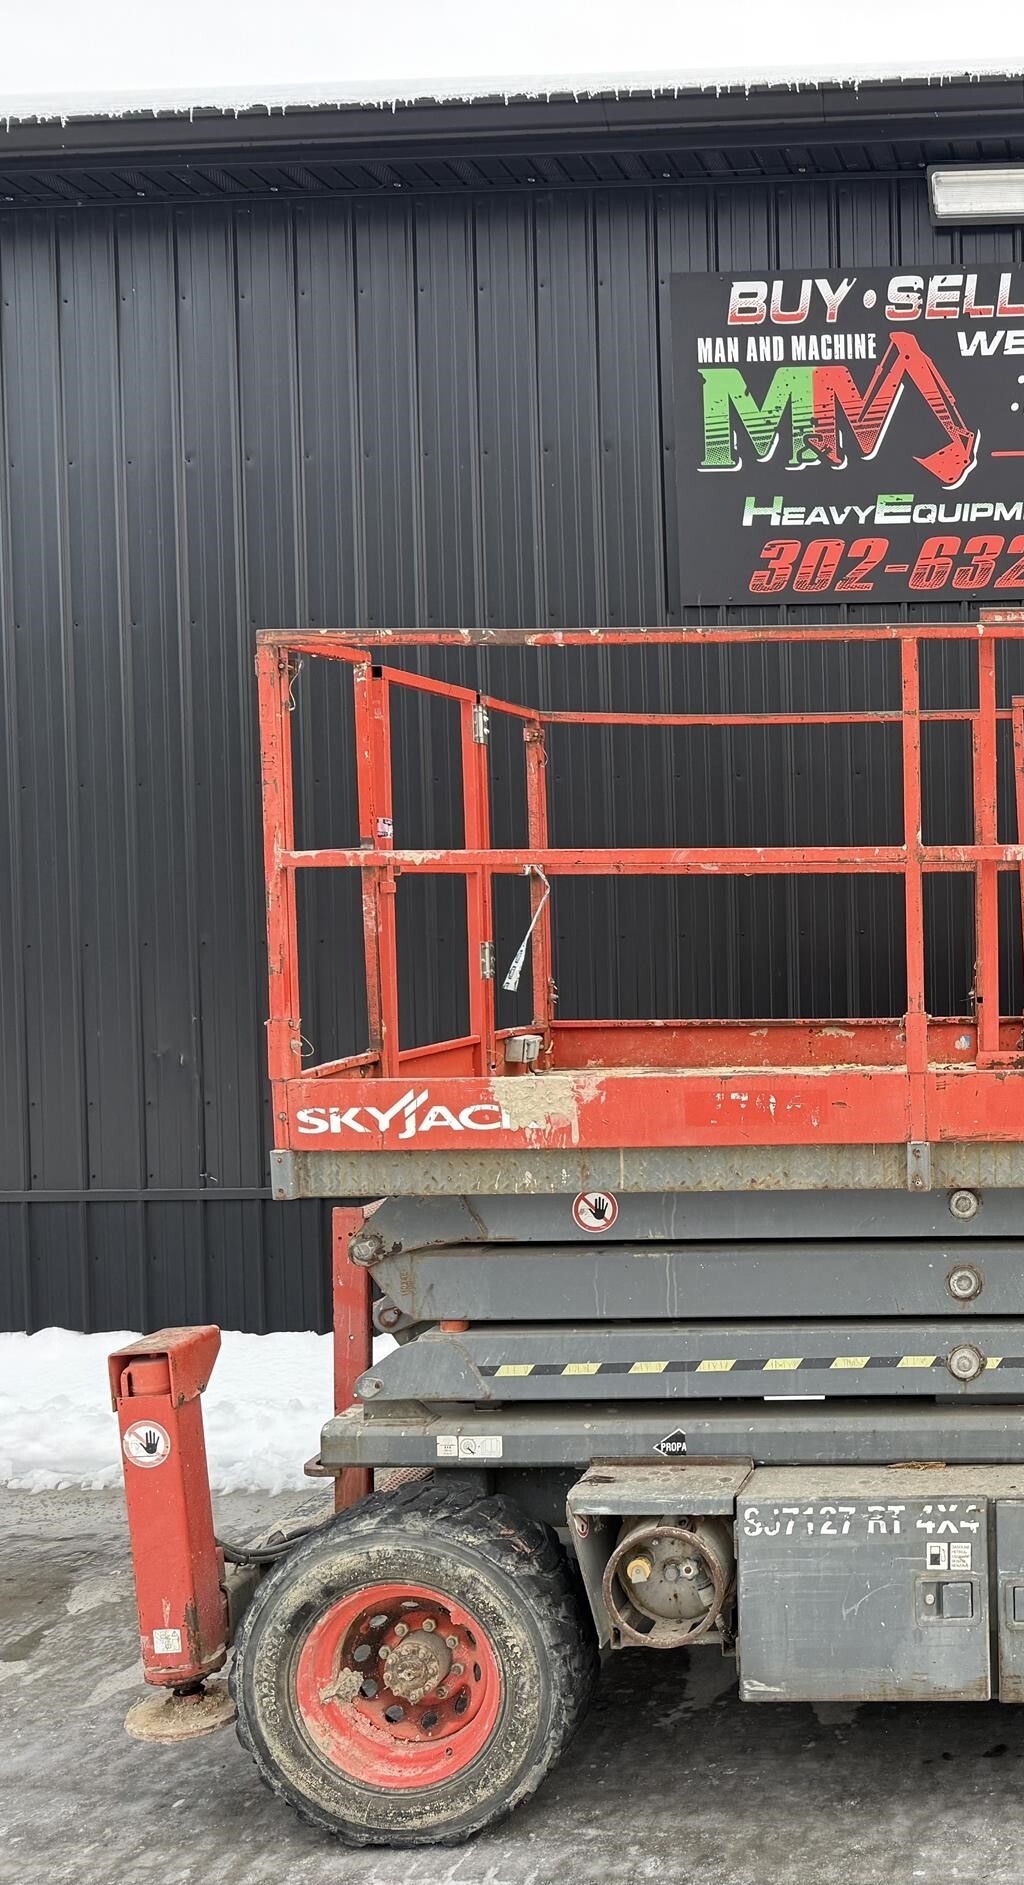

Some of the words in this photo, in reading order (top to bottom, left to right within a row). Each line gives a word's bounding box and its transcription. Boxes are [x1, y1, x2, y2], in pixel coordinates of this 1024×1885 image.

[727, 277, 857, 325] BUY
[697, 337, 740, 363] MAN
[746, 335, 785, 362] AND
[790, 332, 877, 361] MACHINE
[743, 1505, 856, 1537] SJ7127
[866, 1504, 906, 1535] RT
[916, 1503, 983, 1535] 4X4
